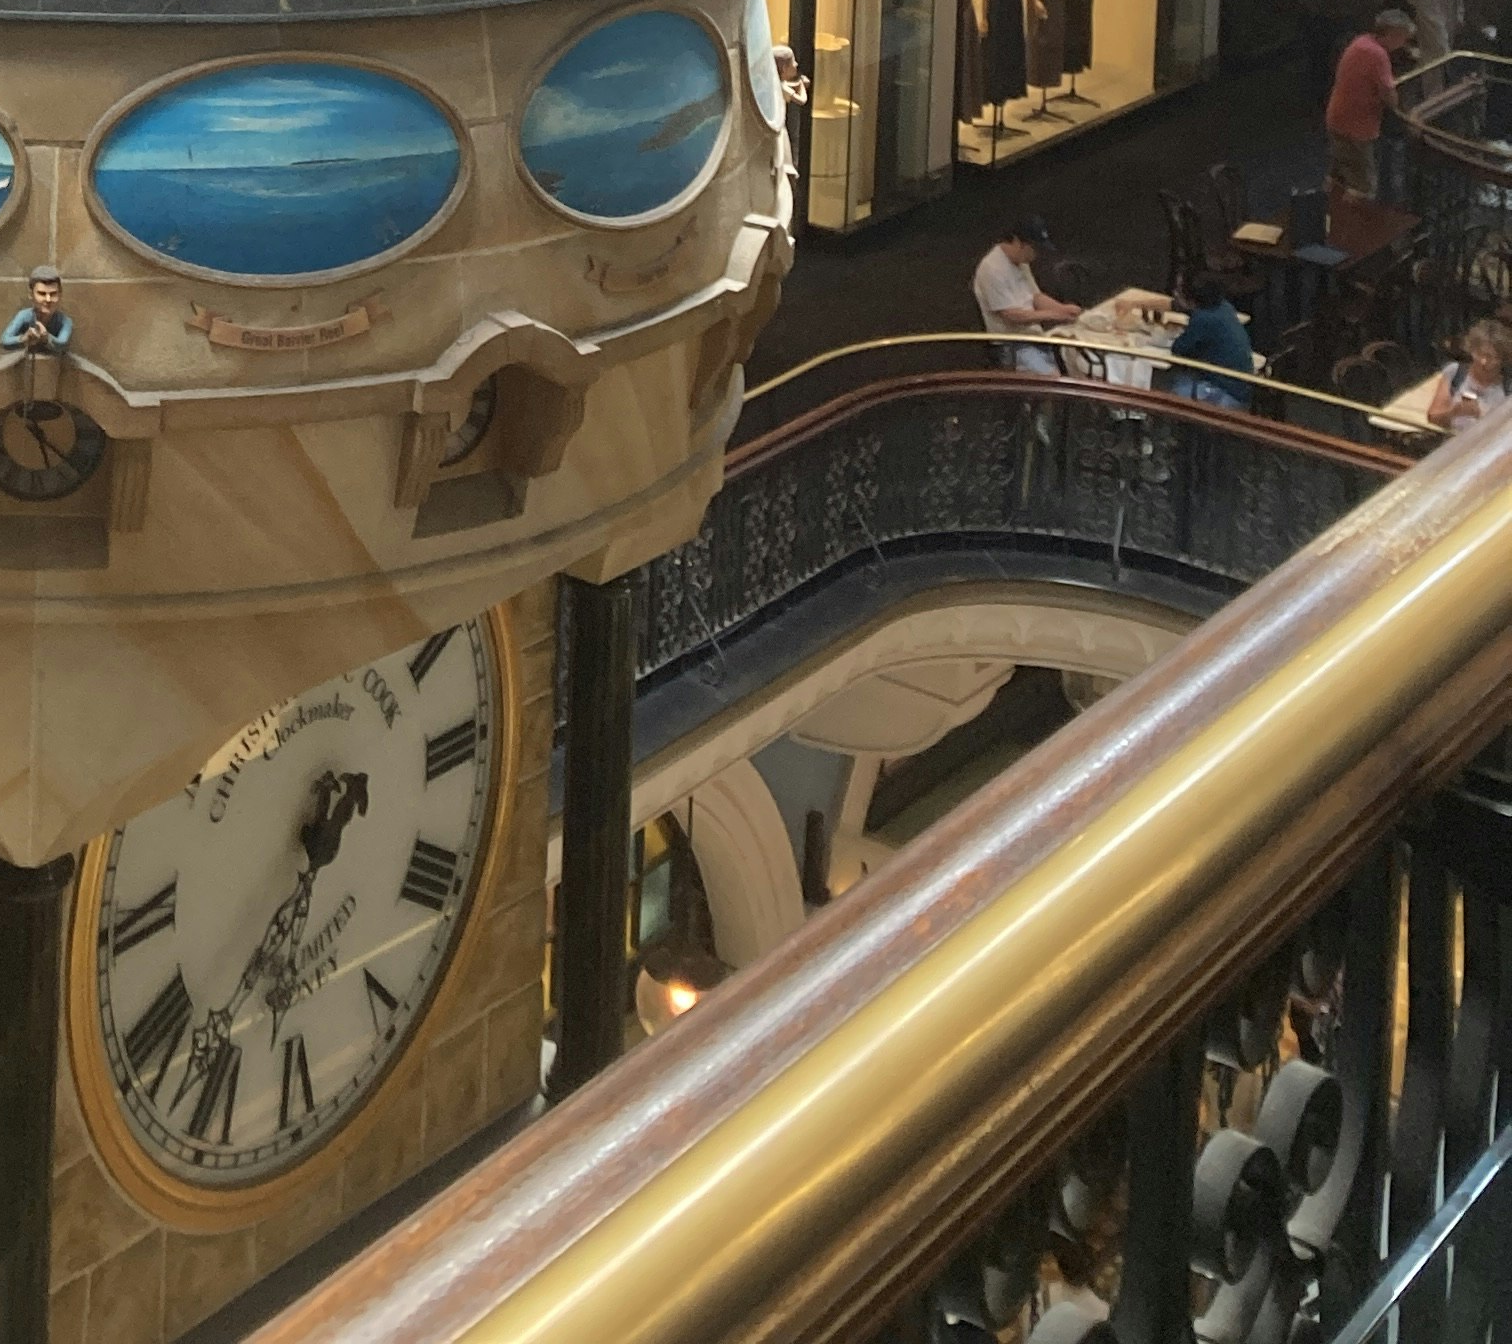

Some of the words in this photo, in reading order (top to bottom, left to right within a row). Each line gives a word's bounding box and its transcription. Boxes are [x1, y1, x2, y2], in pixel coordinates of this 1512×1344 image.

[241, 331, 273, 347] Great
[277, 333, 316, 348] Barrier
[363, 668, 403, 730] COOK
[424, 717, 478, 791] III
[396, 830, 459, 914] IIII
[112, 872, 178, 966] IX
